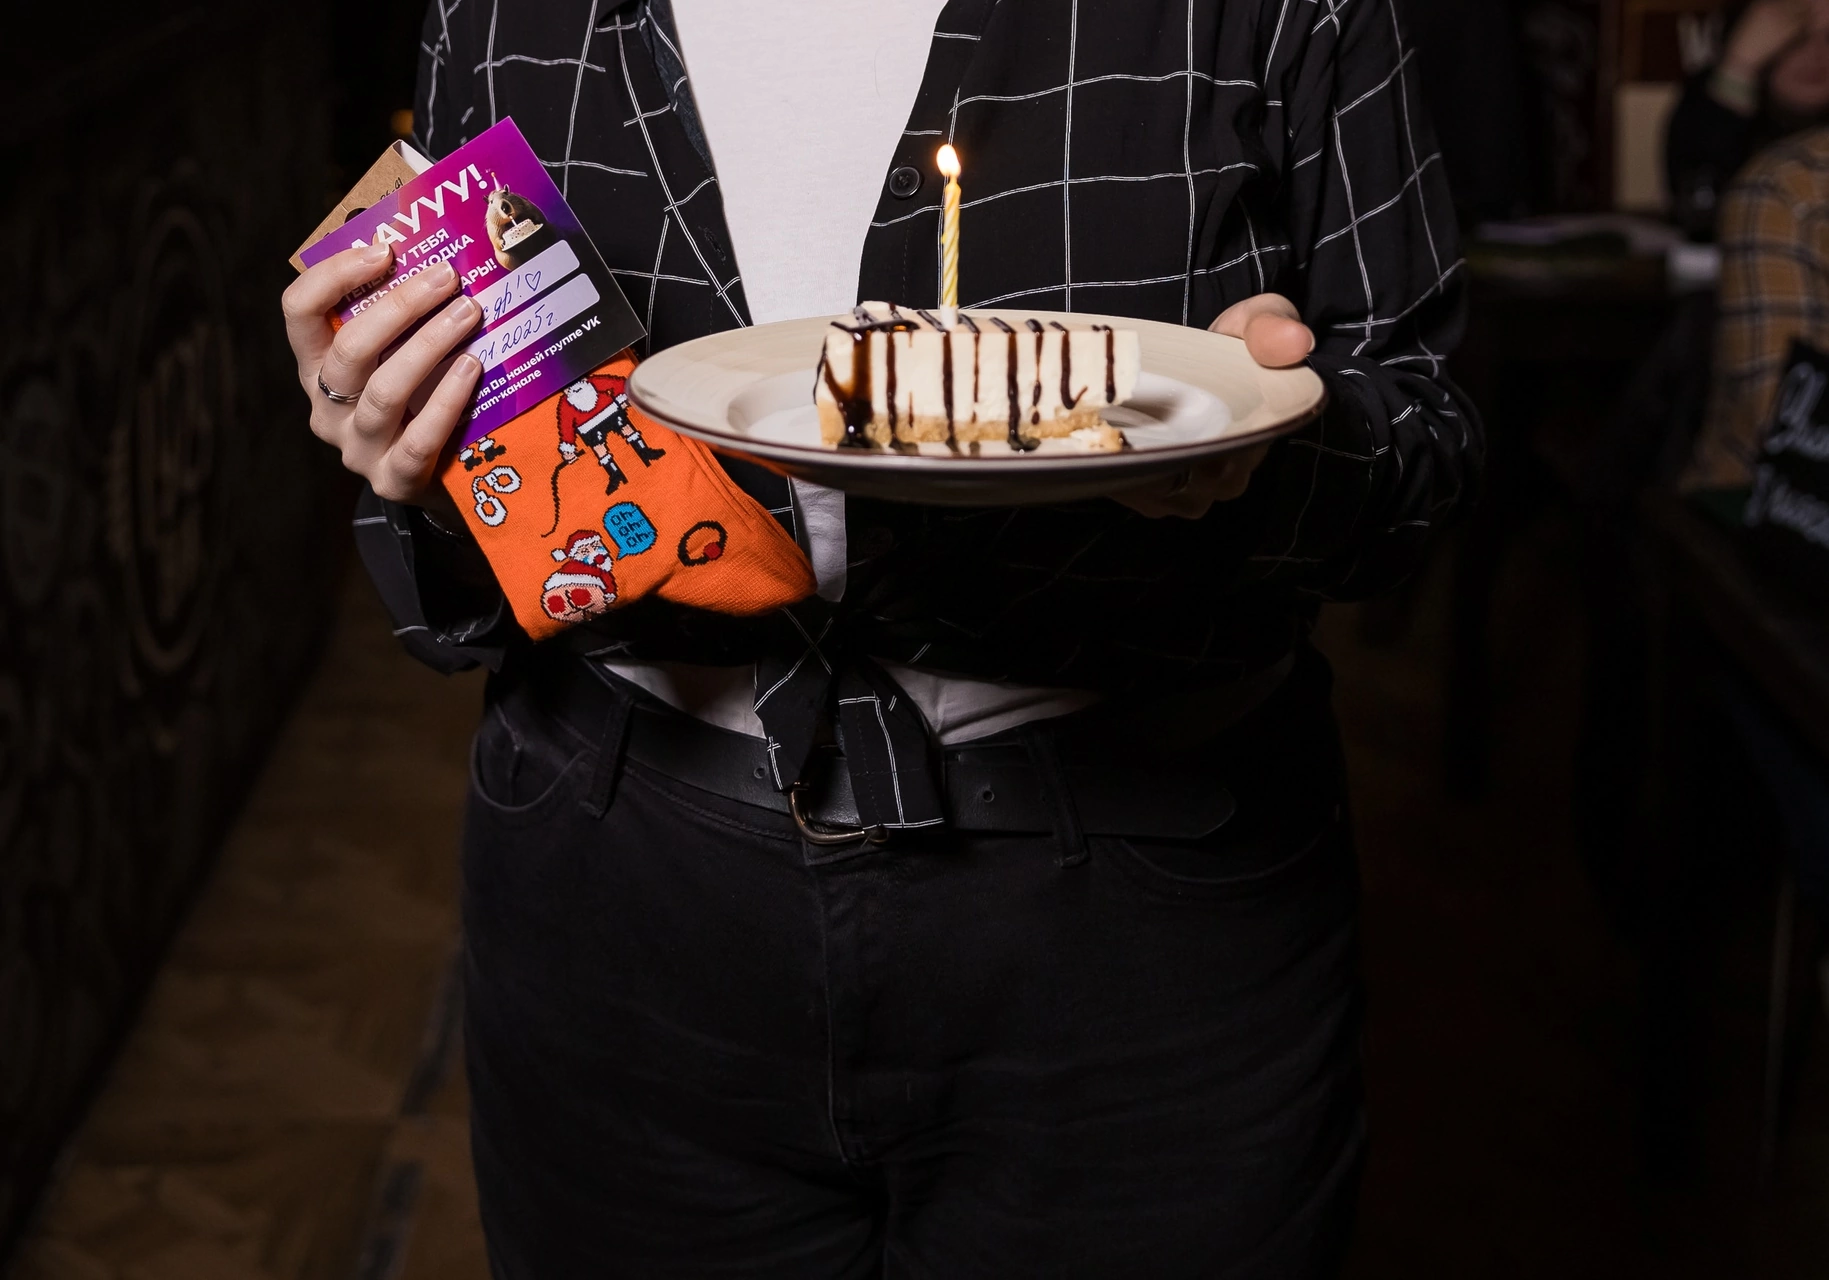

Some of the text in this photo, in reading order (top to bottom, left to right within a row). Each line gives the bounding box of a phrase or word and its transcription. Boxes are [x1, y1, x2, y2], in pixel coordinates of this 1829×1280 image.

[388, 233, 475, 289] ПРОХОДКА
[408, 228, 450, 259] ТЕБЯ
[506, 350, 546, 381] нашей
[543, 328, 584, 357] группе
[581, 315, 602, 332] VK
